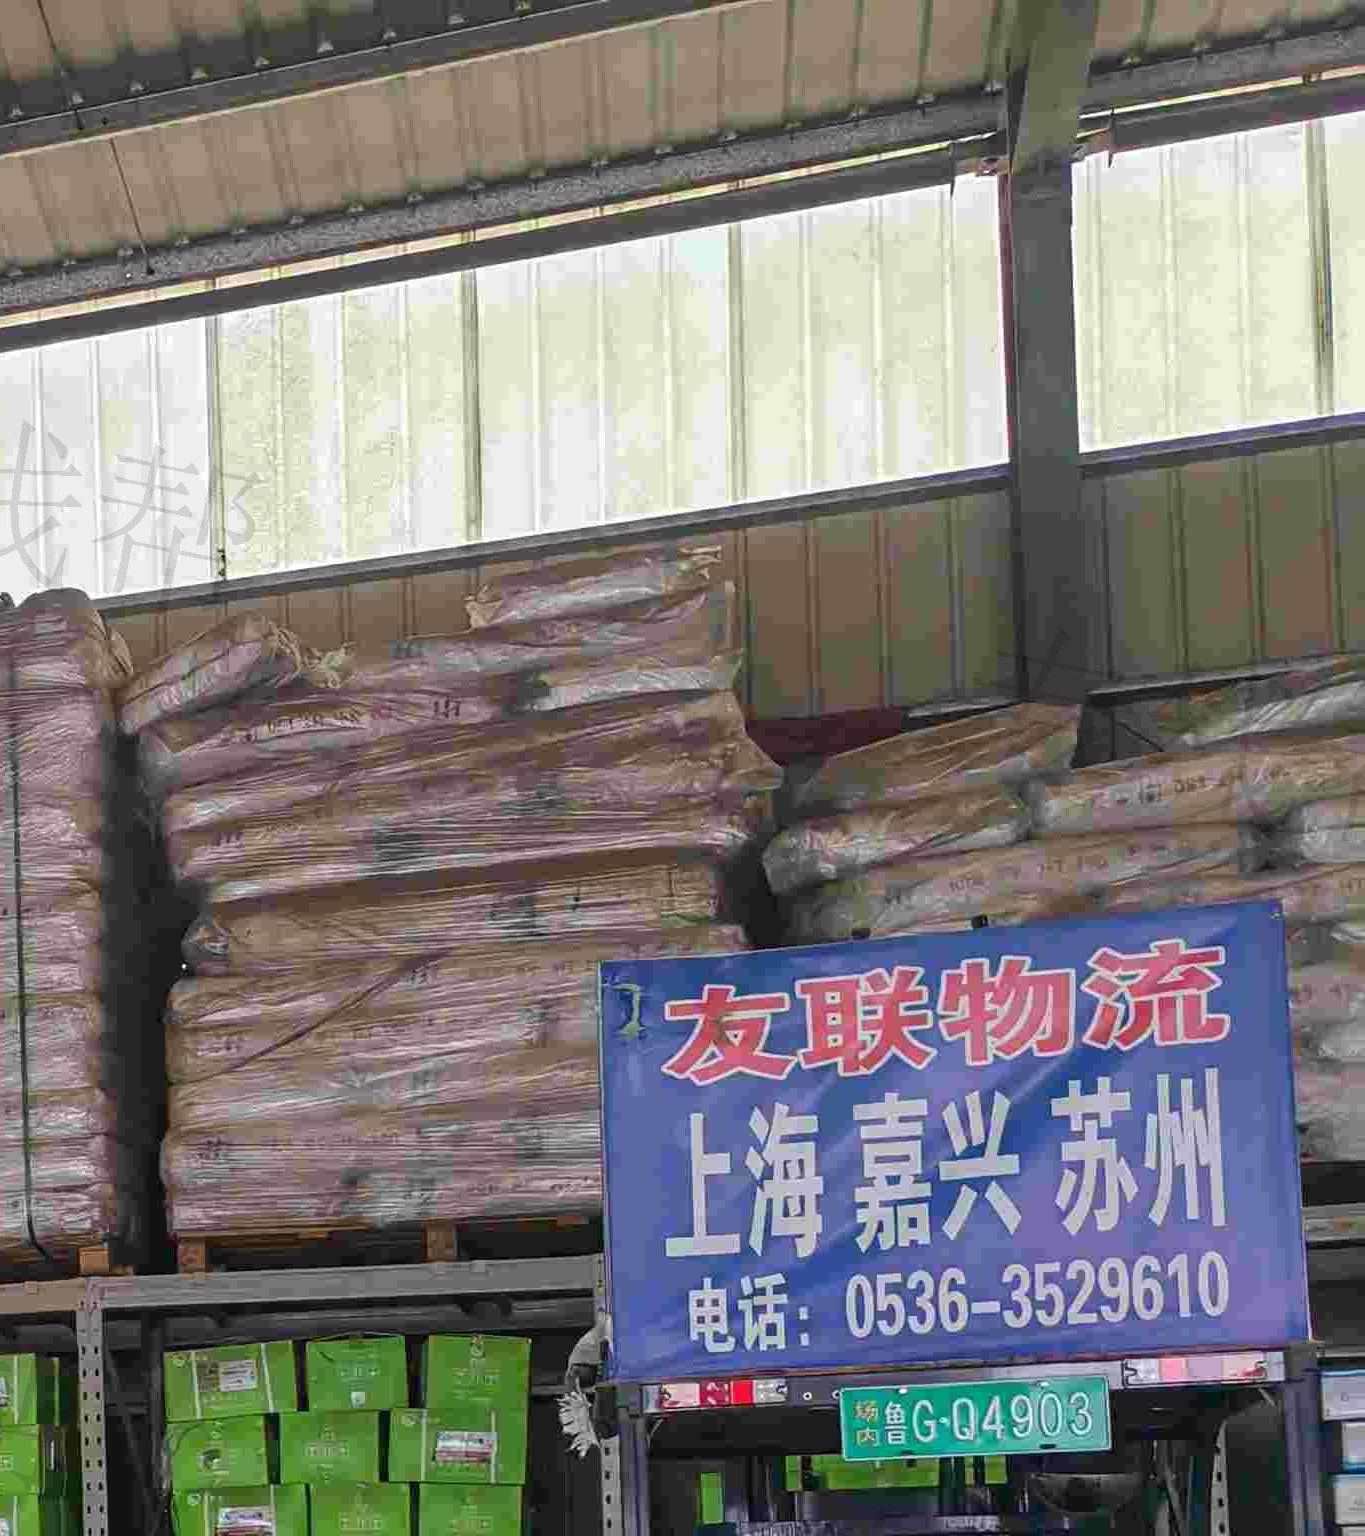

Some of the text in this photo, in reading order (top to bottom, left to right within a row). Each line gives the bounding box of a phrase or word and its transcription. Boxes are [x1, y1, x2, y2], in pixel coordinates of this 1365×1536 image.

[662, 939, 1231, 1086] 友联物流
[664, 1067, 1227, 1259] 上海 嘉兴 苏州
[688, 1250, 1229, 1355] 电话： 0536-3529610
